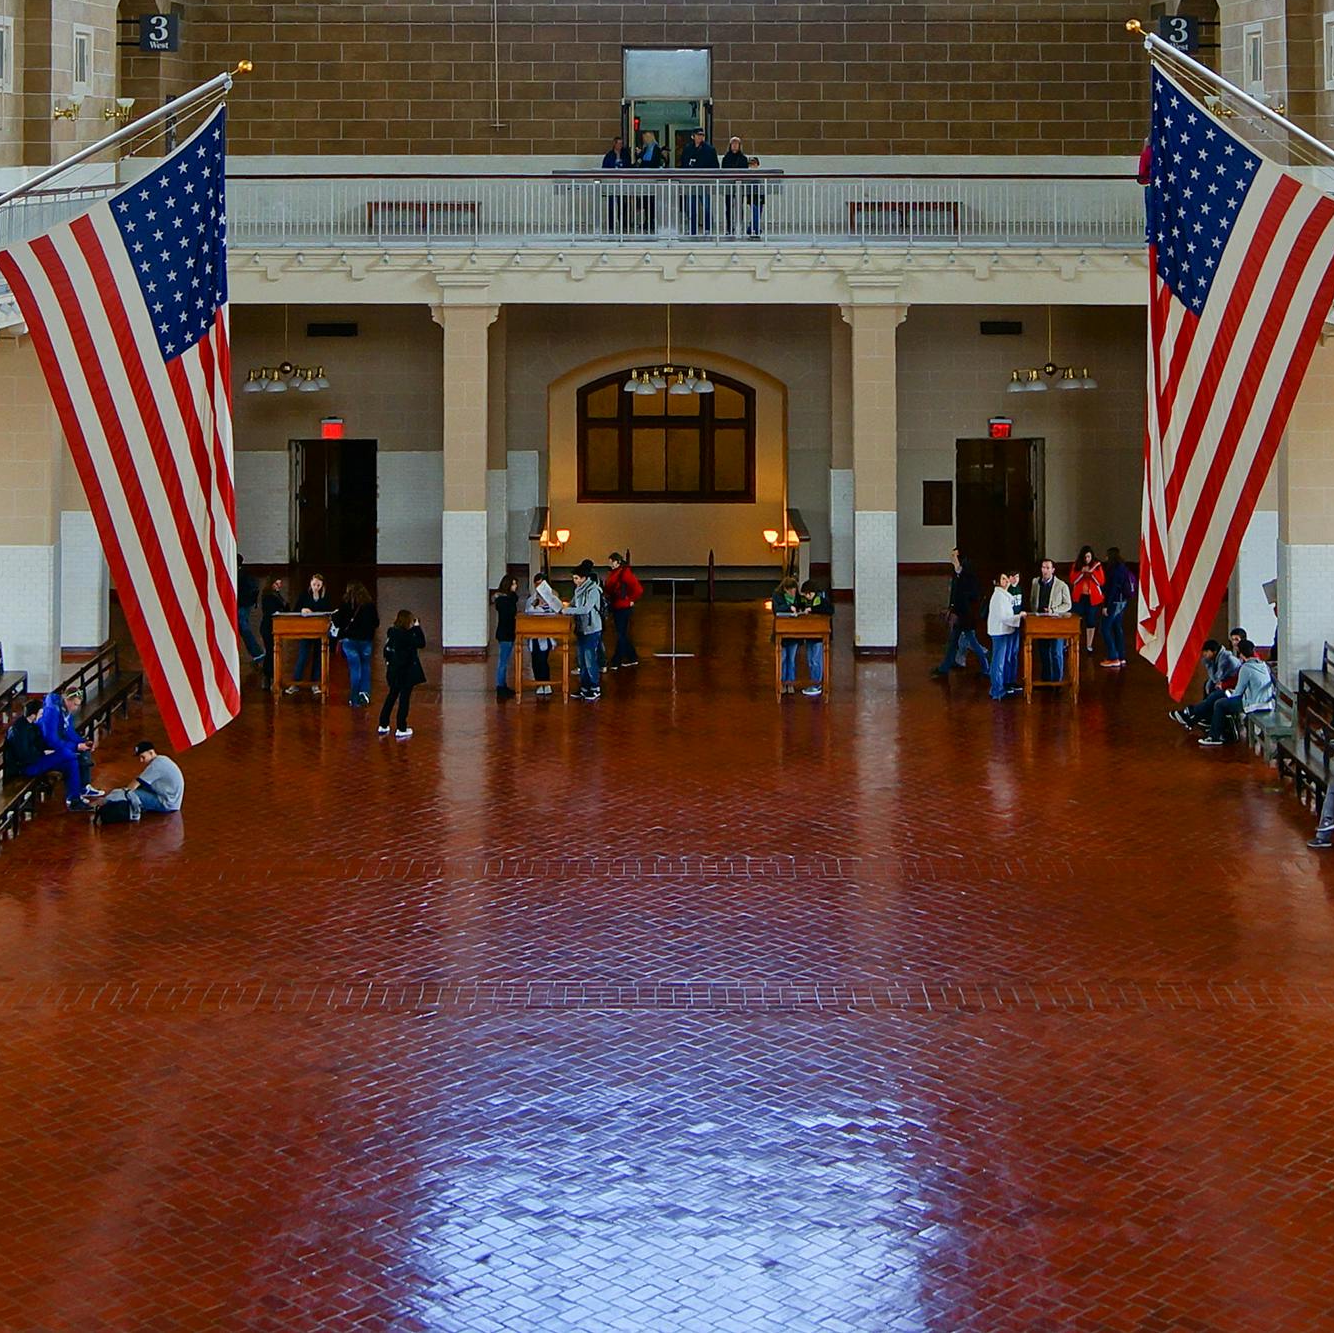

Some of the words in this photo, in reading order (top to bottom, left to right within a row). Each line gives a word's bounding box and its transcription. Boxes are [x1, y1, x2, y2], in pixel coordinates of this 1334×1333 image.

[149, 15, 169, 41] 3
[1169, 17, 1188, 43] 3
[149, 41, 169, 49] West
